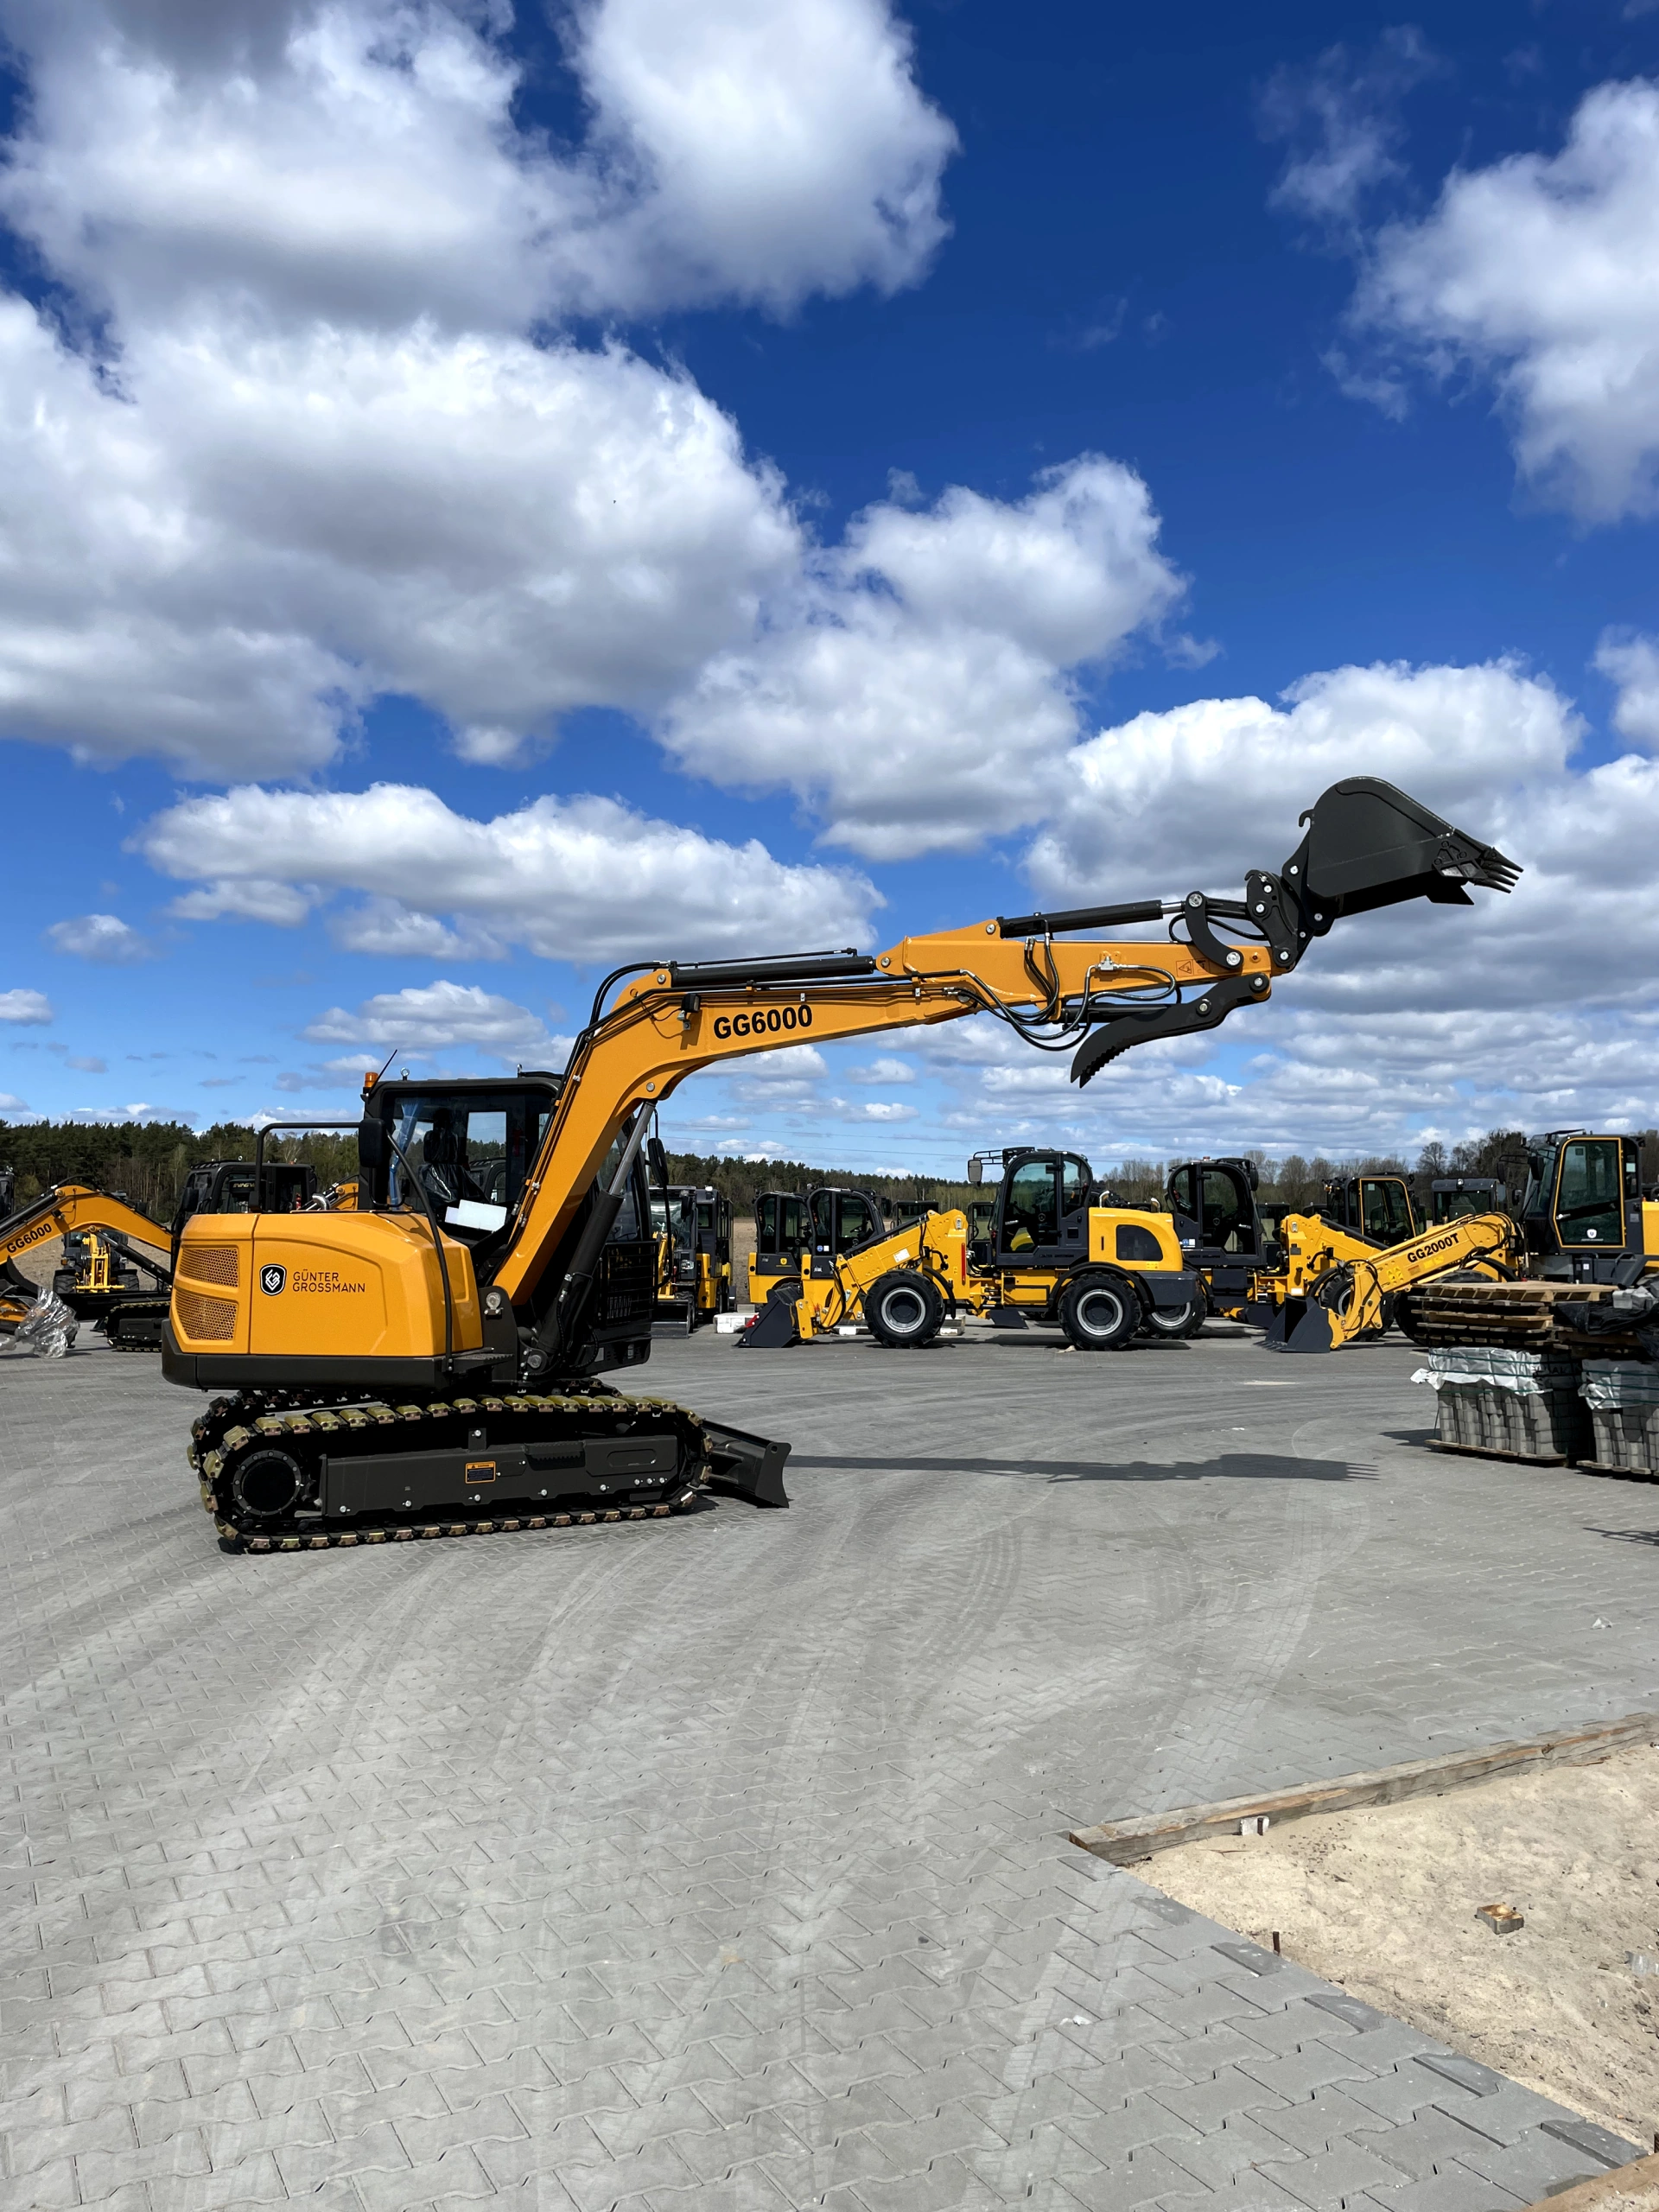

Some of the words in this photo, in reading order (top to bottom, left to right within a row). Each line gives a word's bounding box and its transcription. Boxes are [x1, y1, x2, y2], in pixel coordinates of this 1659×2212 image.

[714, 1004, 812, 1039] GG6000
[7, 1224, 52, 1253] GG6000
[1408, 1233, 1459, 1262] GG2000T
[292, 1282, 365, 1293] GROSSMANN
[293, 1268, 339, 1281] GÜNTER
